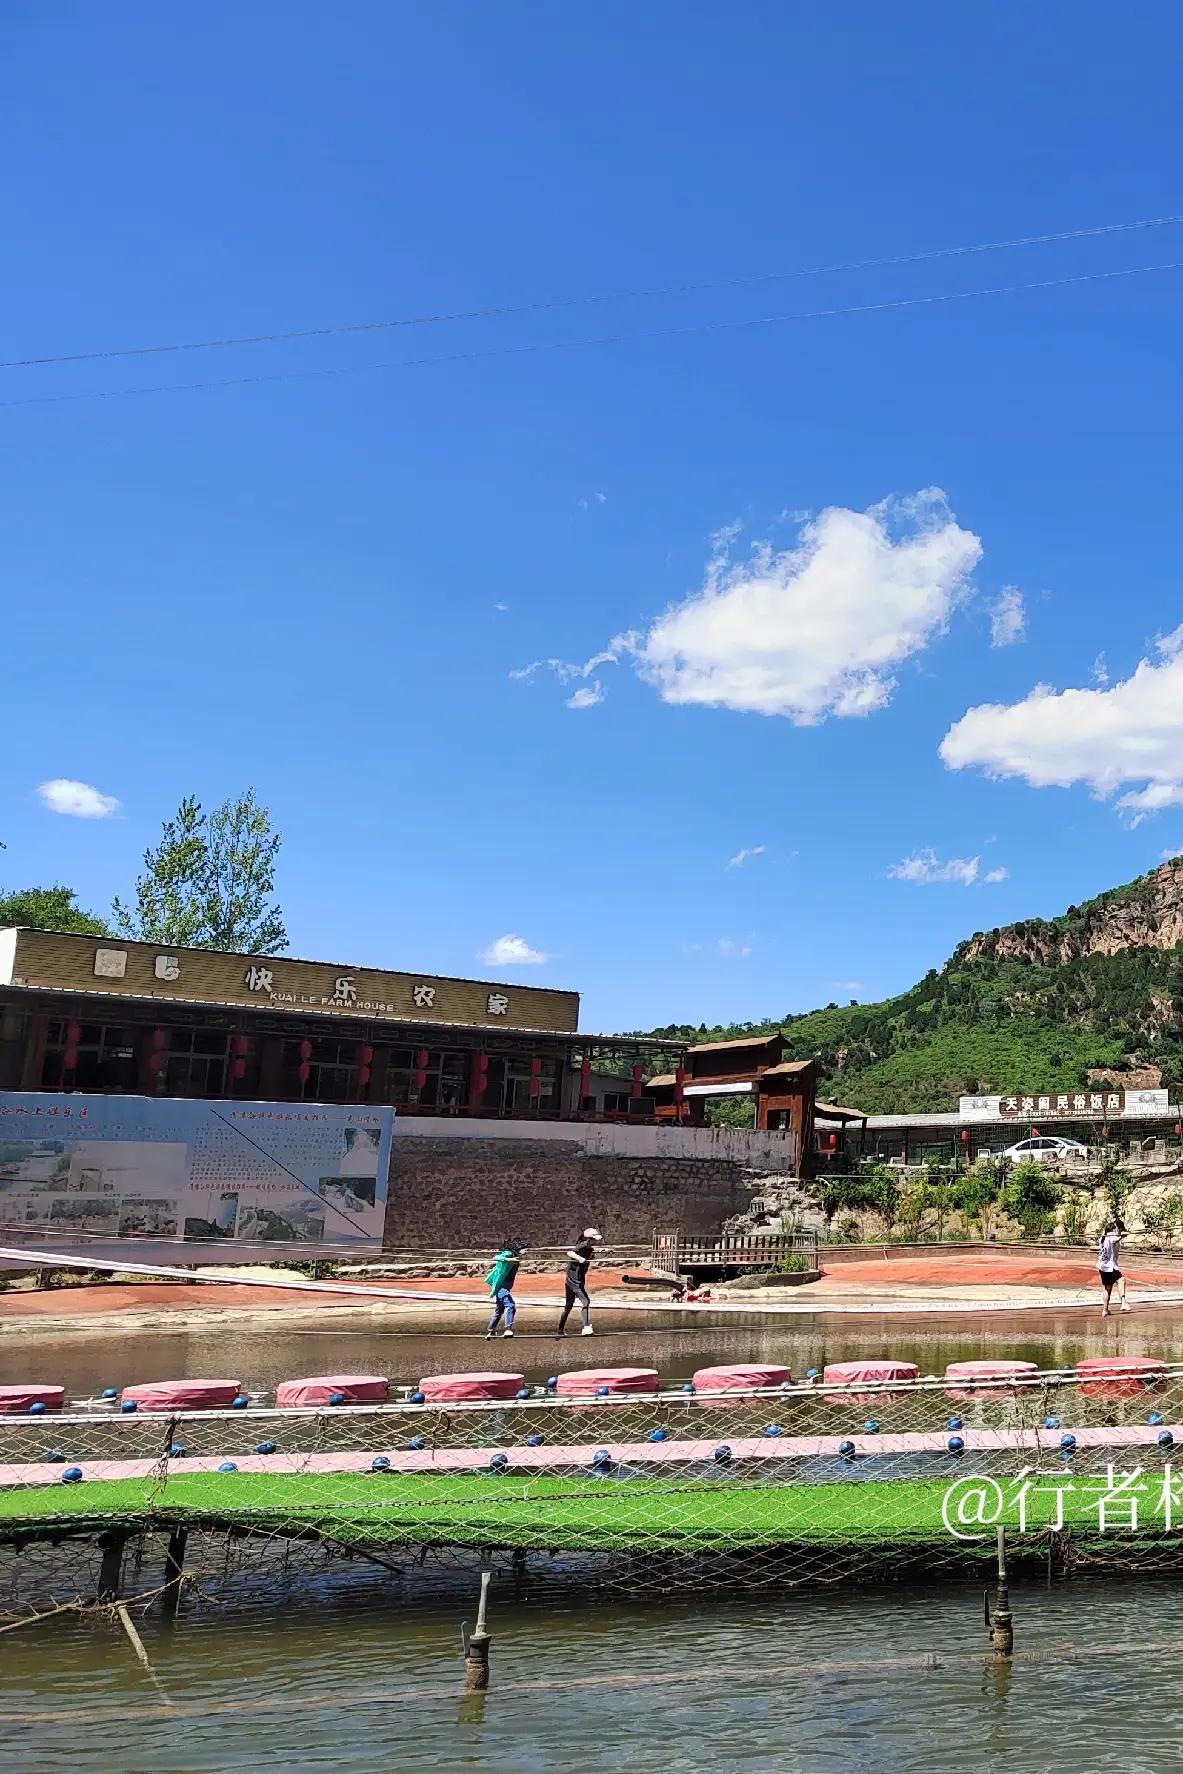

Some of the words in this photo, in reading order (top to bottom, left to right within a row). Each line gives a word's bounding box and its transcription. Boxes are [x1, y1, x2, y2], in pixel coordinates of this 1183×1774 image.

[245, 966, 509, 1015] 快乐农家
[269, 991, 297, 1003] KUAI
[300, 992, 316, 1004] LE
[321, 997, 352, 1009] FARM
[356, 1001, 394, 1012] HOUSE
